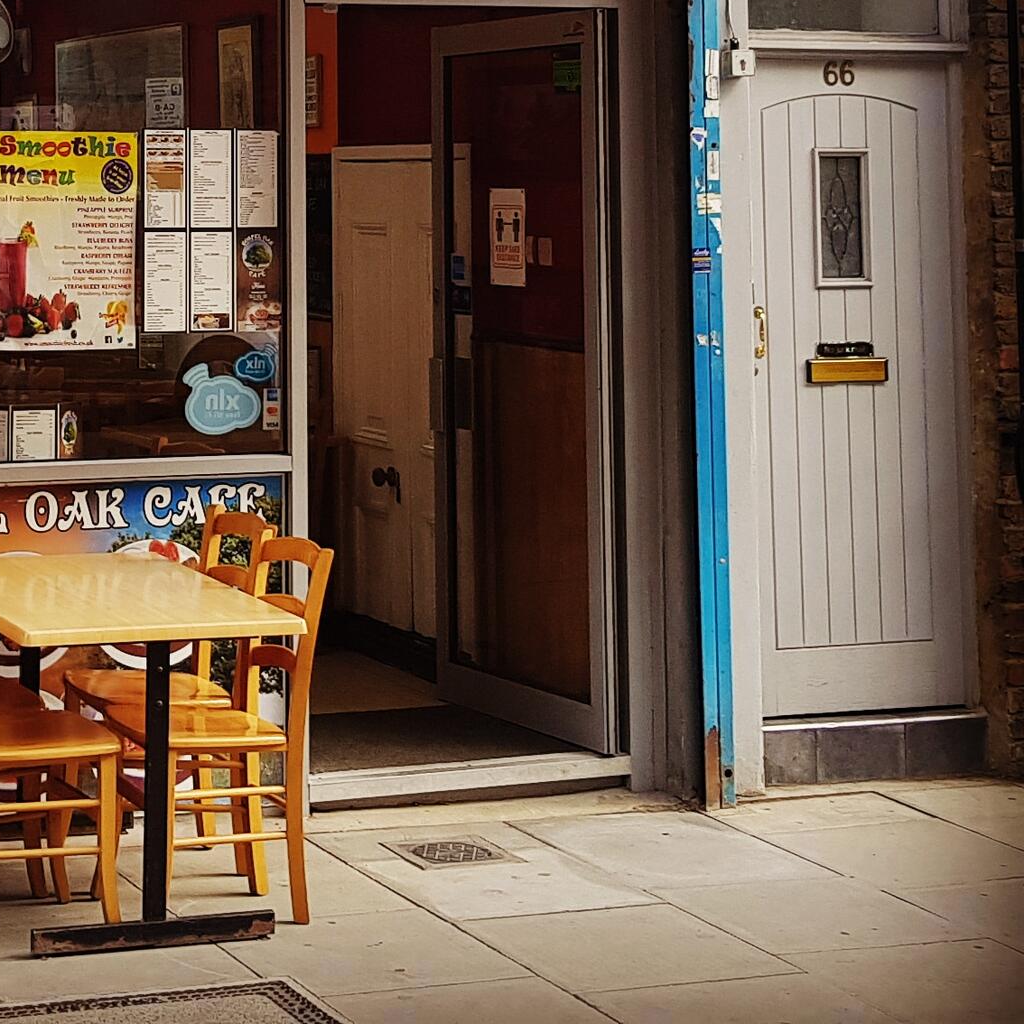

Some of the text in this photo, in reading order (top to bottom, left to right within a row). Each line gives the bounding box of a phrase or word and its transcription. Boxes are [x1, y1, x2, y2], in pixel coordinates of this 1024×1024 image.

[823, 60, 855, 86] 66
[0, 135, 131, 158] Smoothie
[65, 195, 86, 204] Freshly
[246, 356, 265, 369] xln
[26, 488, 129, 533] OAK
